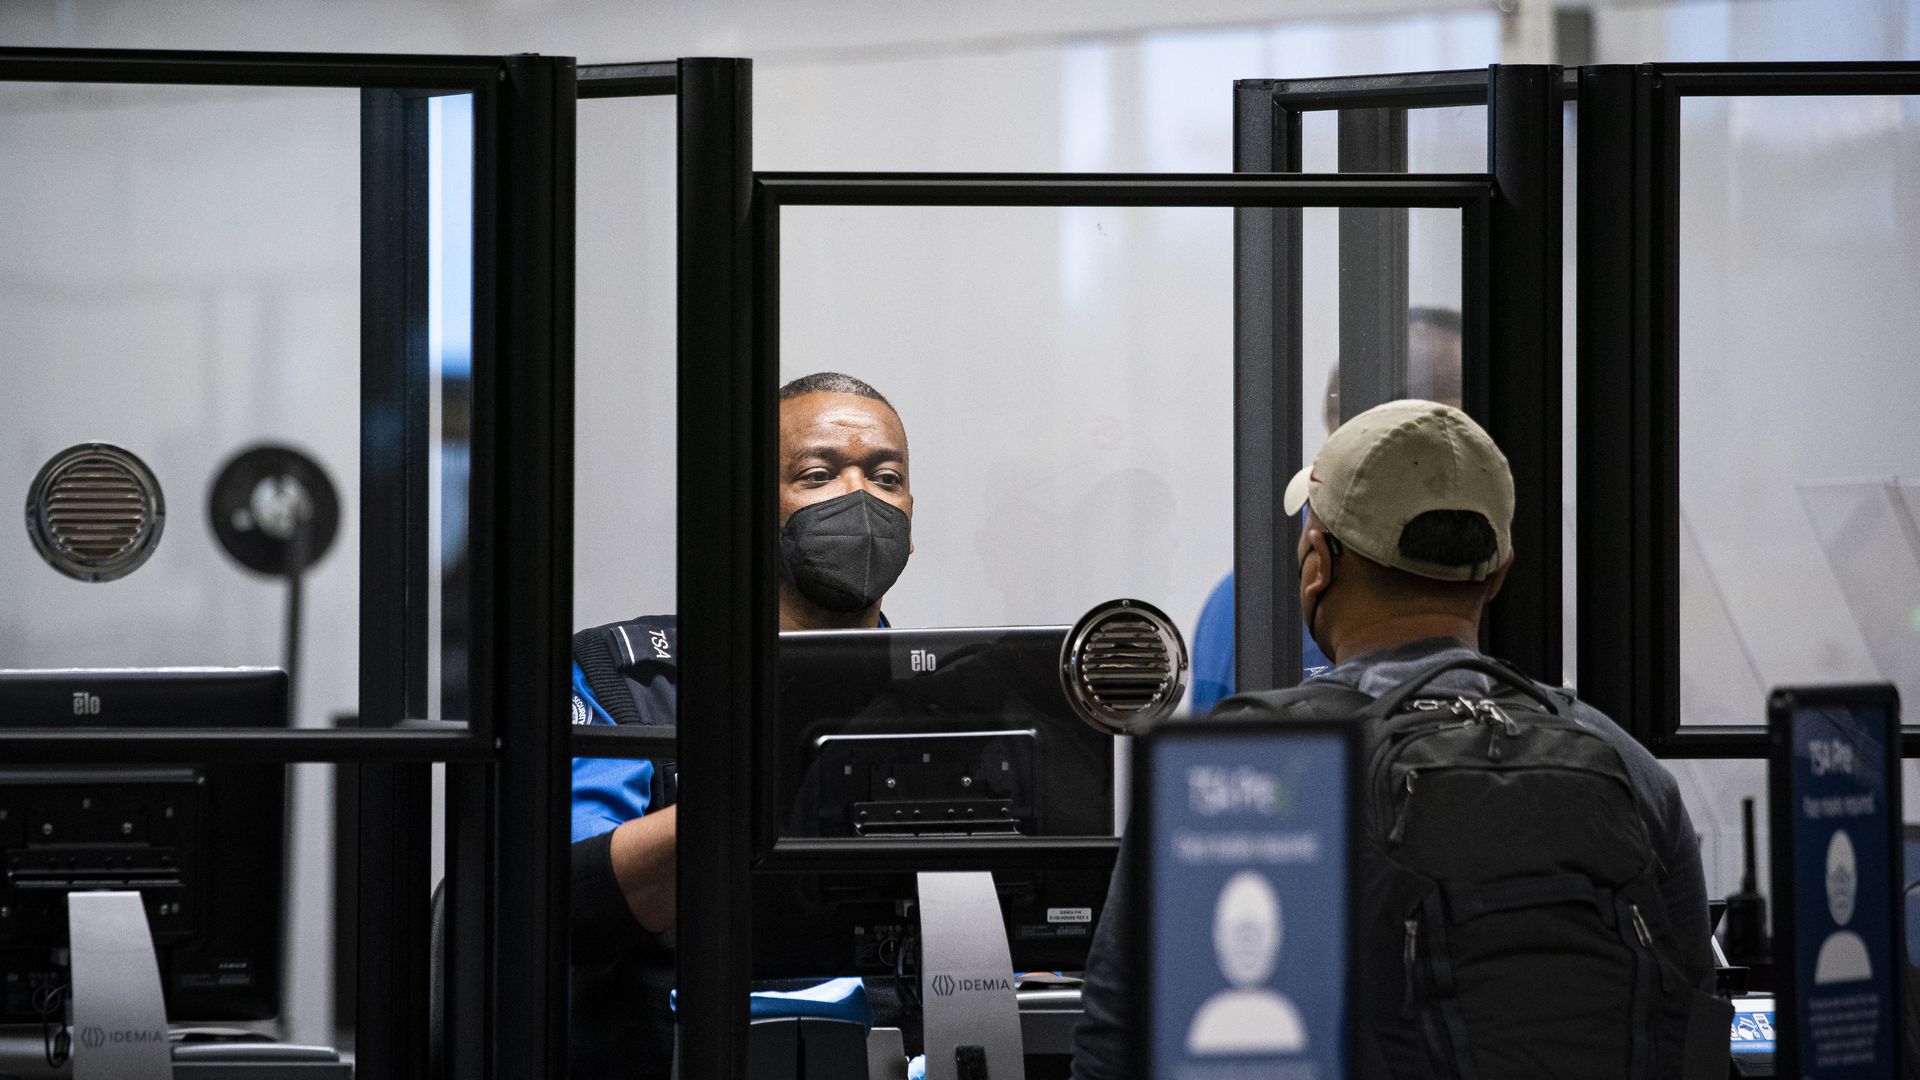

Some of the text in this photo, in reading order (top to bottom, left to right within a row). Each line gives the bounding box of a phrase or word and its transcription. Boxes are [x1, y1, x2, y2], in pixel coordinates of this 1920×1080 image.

[649, 630, 671, 658] TSA
[959, 979, 1010, 991] IDEMIA
[109, 1030, 163, 1043] IDEMIA
